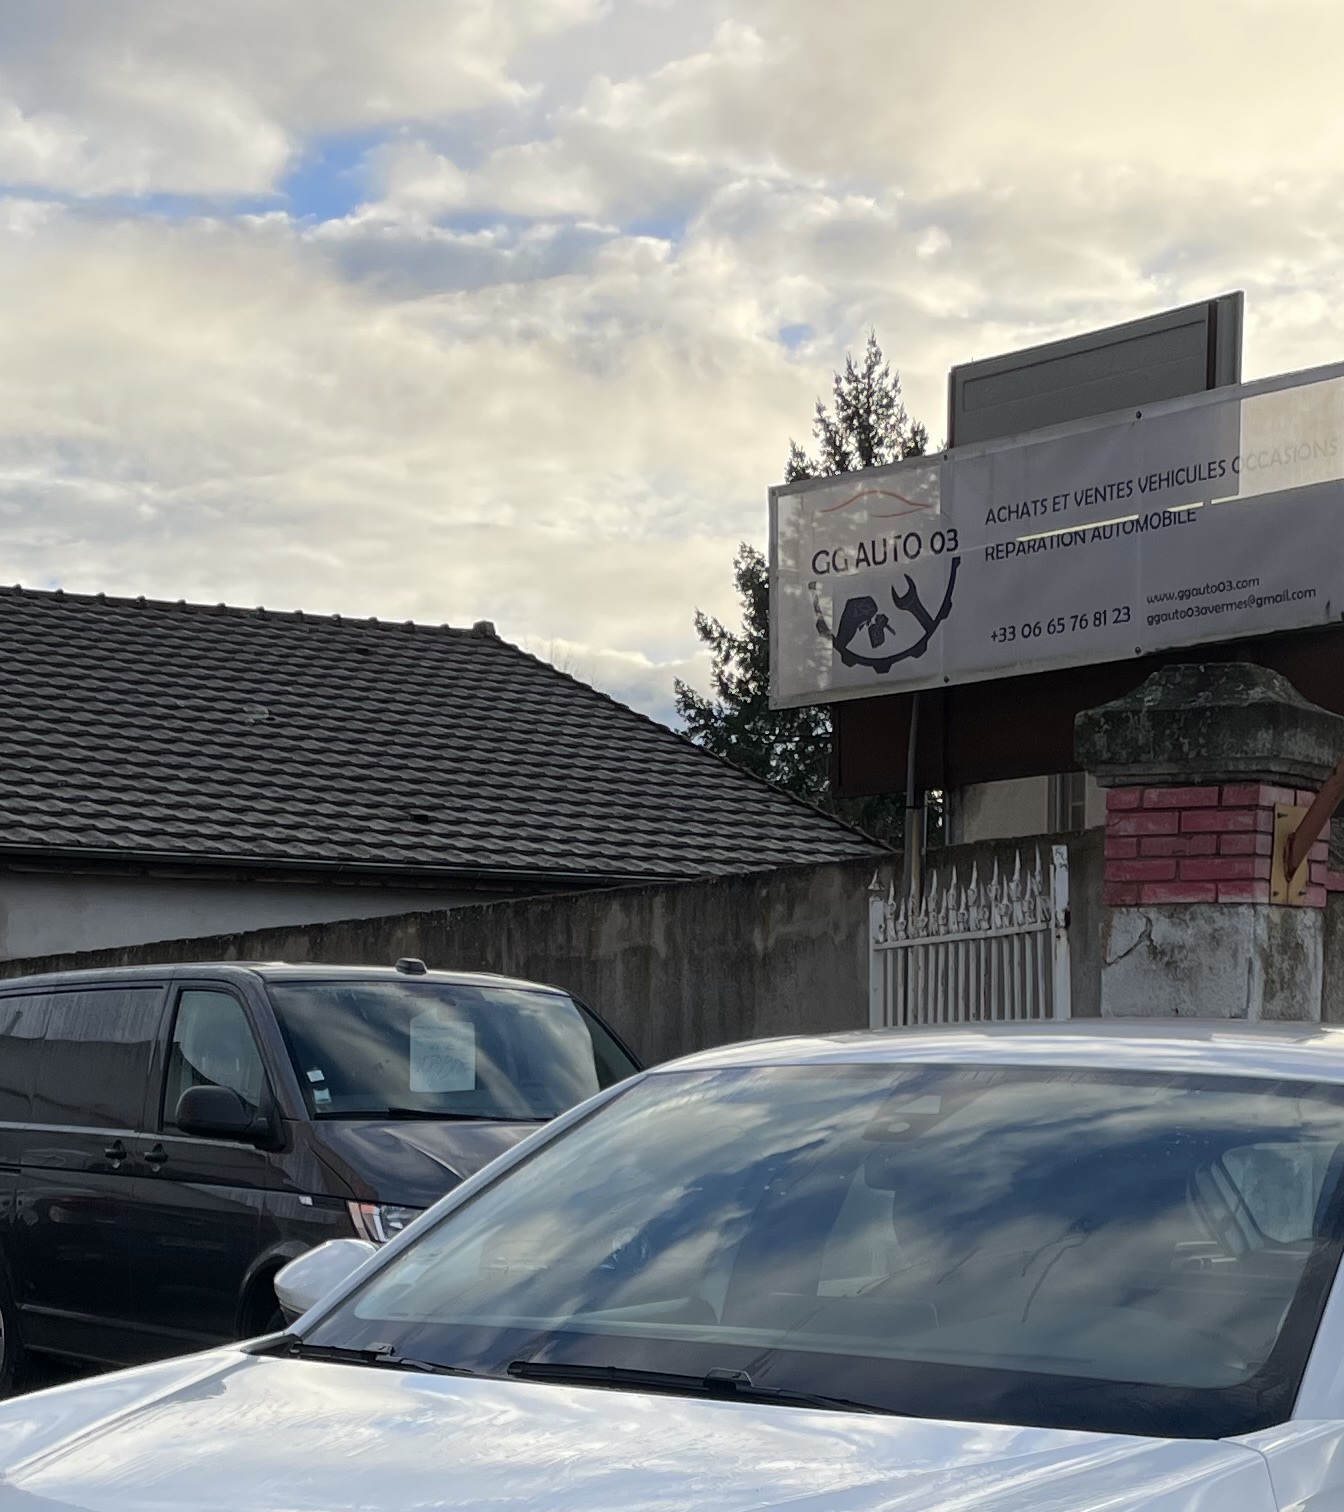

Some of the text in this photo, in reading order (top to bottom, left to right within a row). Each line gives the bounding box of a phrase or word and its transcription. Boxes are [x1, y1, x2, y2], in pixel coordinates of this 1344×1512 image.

[985, 438, 1338, 526] ACHATS ET VENTES VEHICULES OCCASIONS
[811, 528, 959, 576] GG AUTO 03
[985, 508, 1197, 563] REPARATION AUTOMOBILE
[1146, 577, 1260, 605] www.ggauto03.com
[1146, 588, 1317, 626] ggauto03avermes@gmail.com
[990, 606, 1131, 643] +33 06 65 76 81 23
